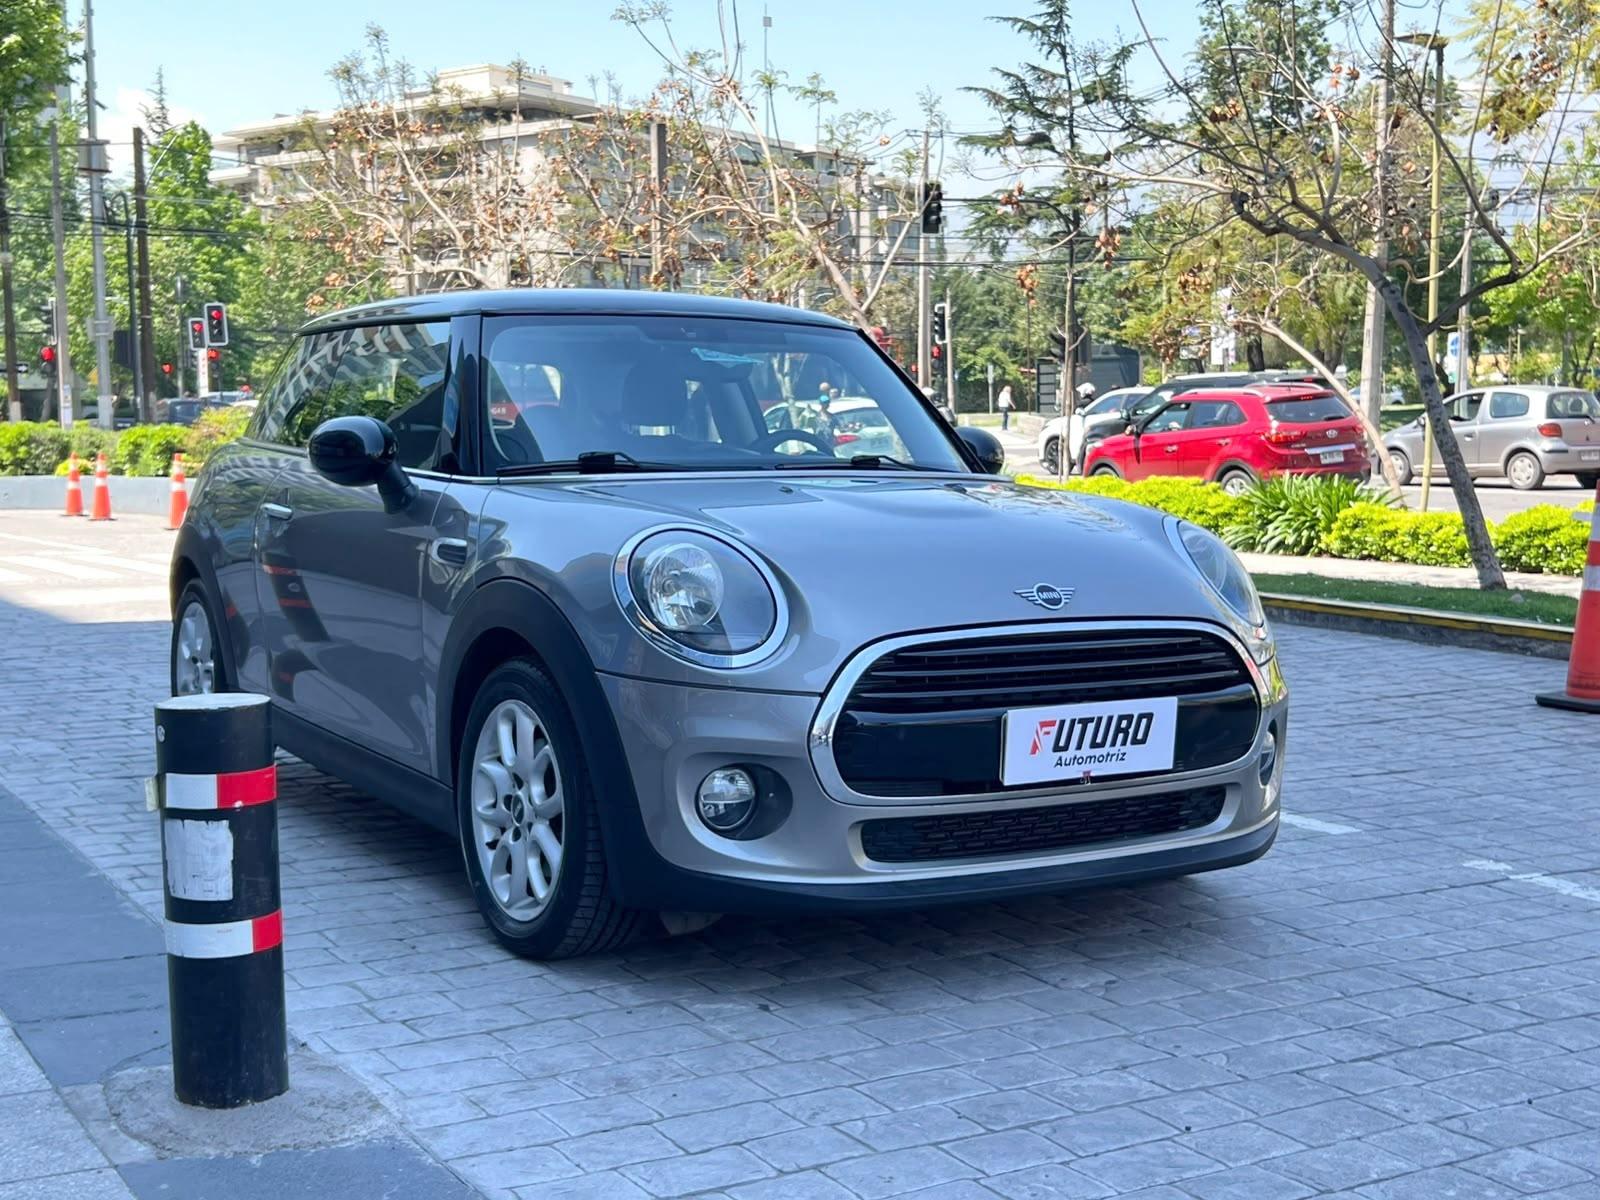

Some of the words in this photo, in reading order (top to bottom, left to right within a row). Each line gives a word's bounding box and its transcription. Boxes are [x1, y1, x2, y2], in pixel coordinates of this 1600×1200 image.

[1038, 591, 1061, 600] MINI
[1029, 712, 1154, 755] FUTURO
[1054, 749, 1127, 767] Automotriz
